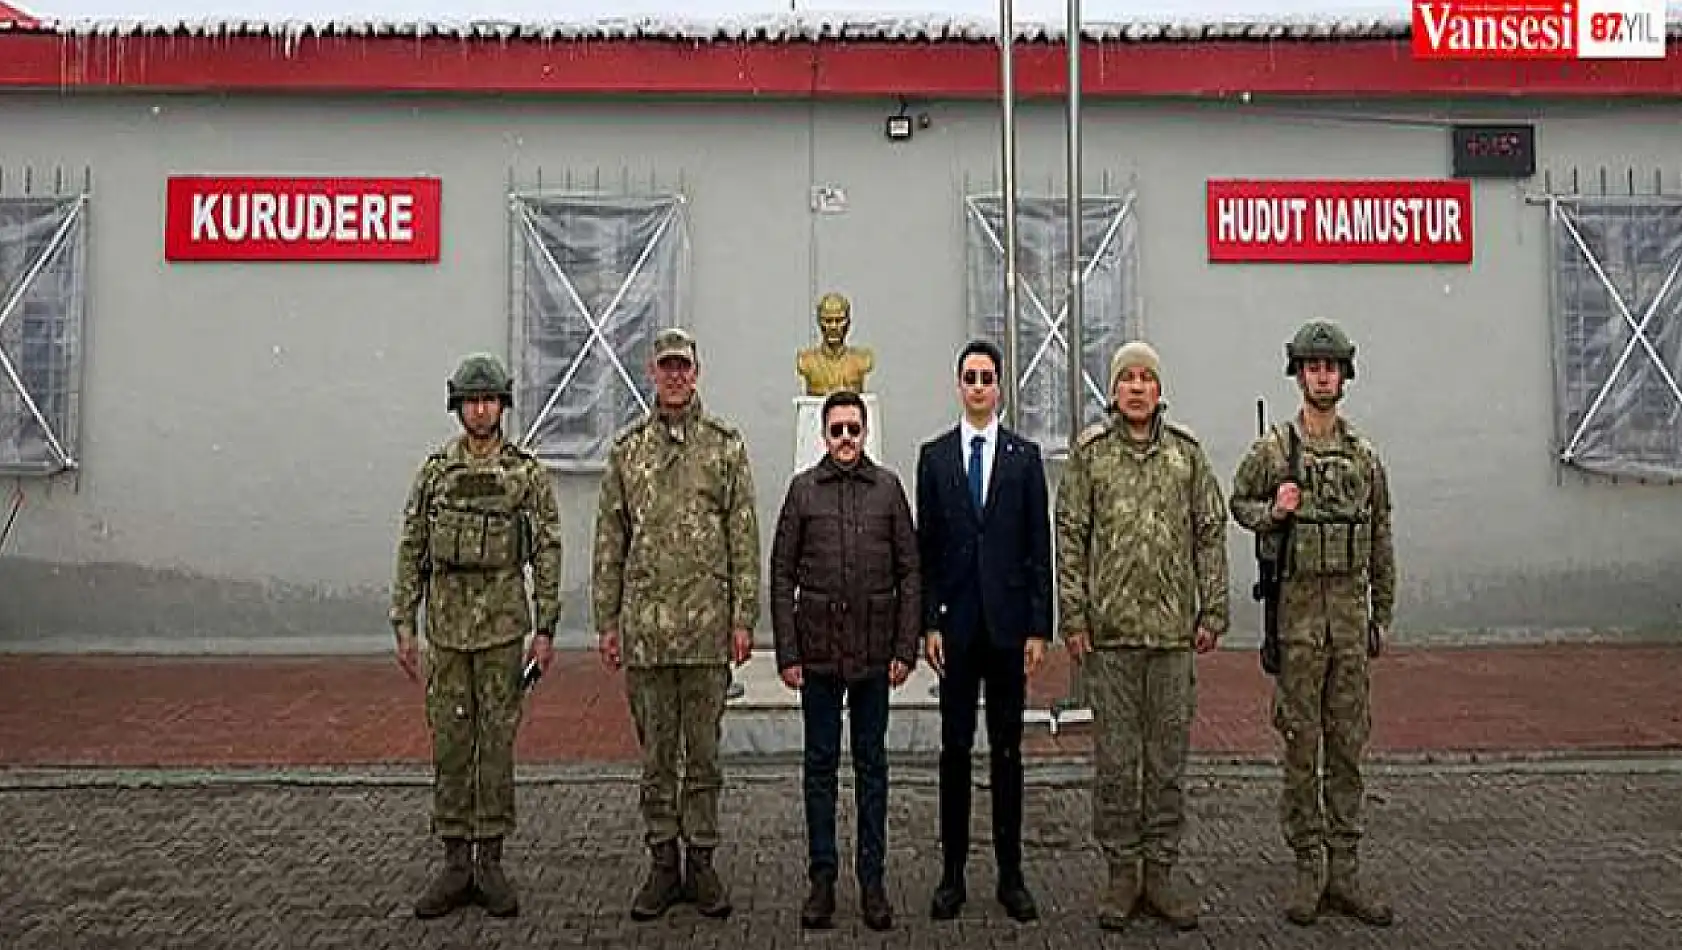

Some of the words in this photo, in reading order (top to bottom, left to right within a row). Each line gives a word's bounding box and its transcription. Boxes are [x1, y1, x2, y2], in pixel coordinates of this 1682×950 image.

[190, 193, 414, 241] KURUDERE
[1217, 198, 1307, 243] HUDUT
[1315, 198, 1462, 243] NAMUSTUR
